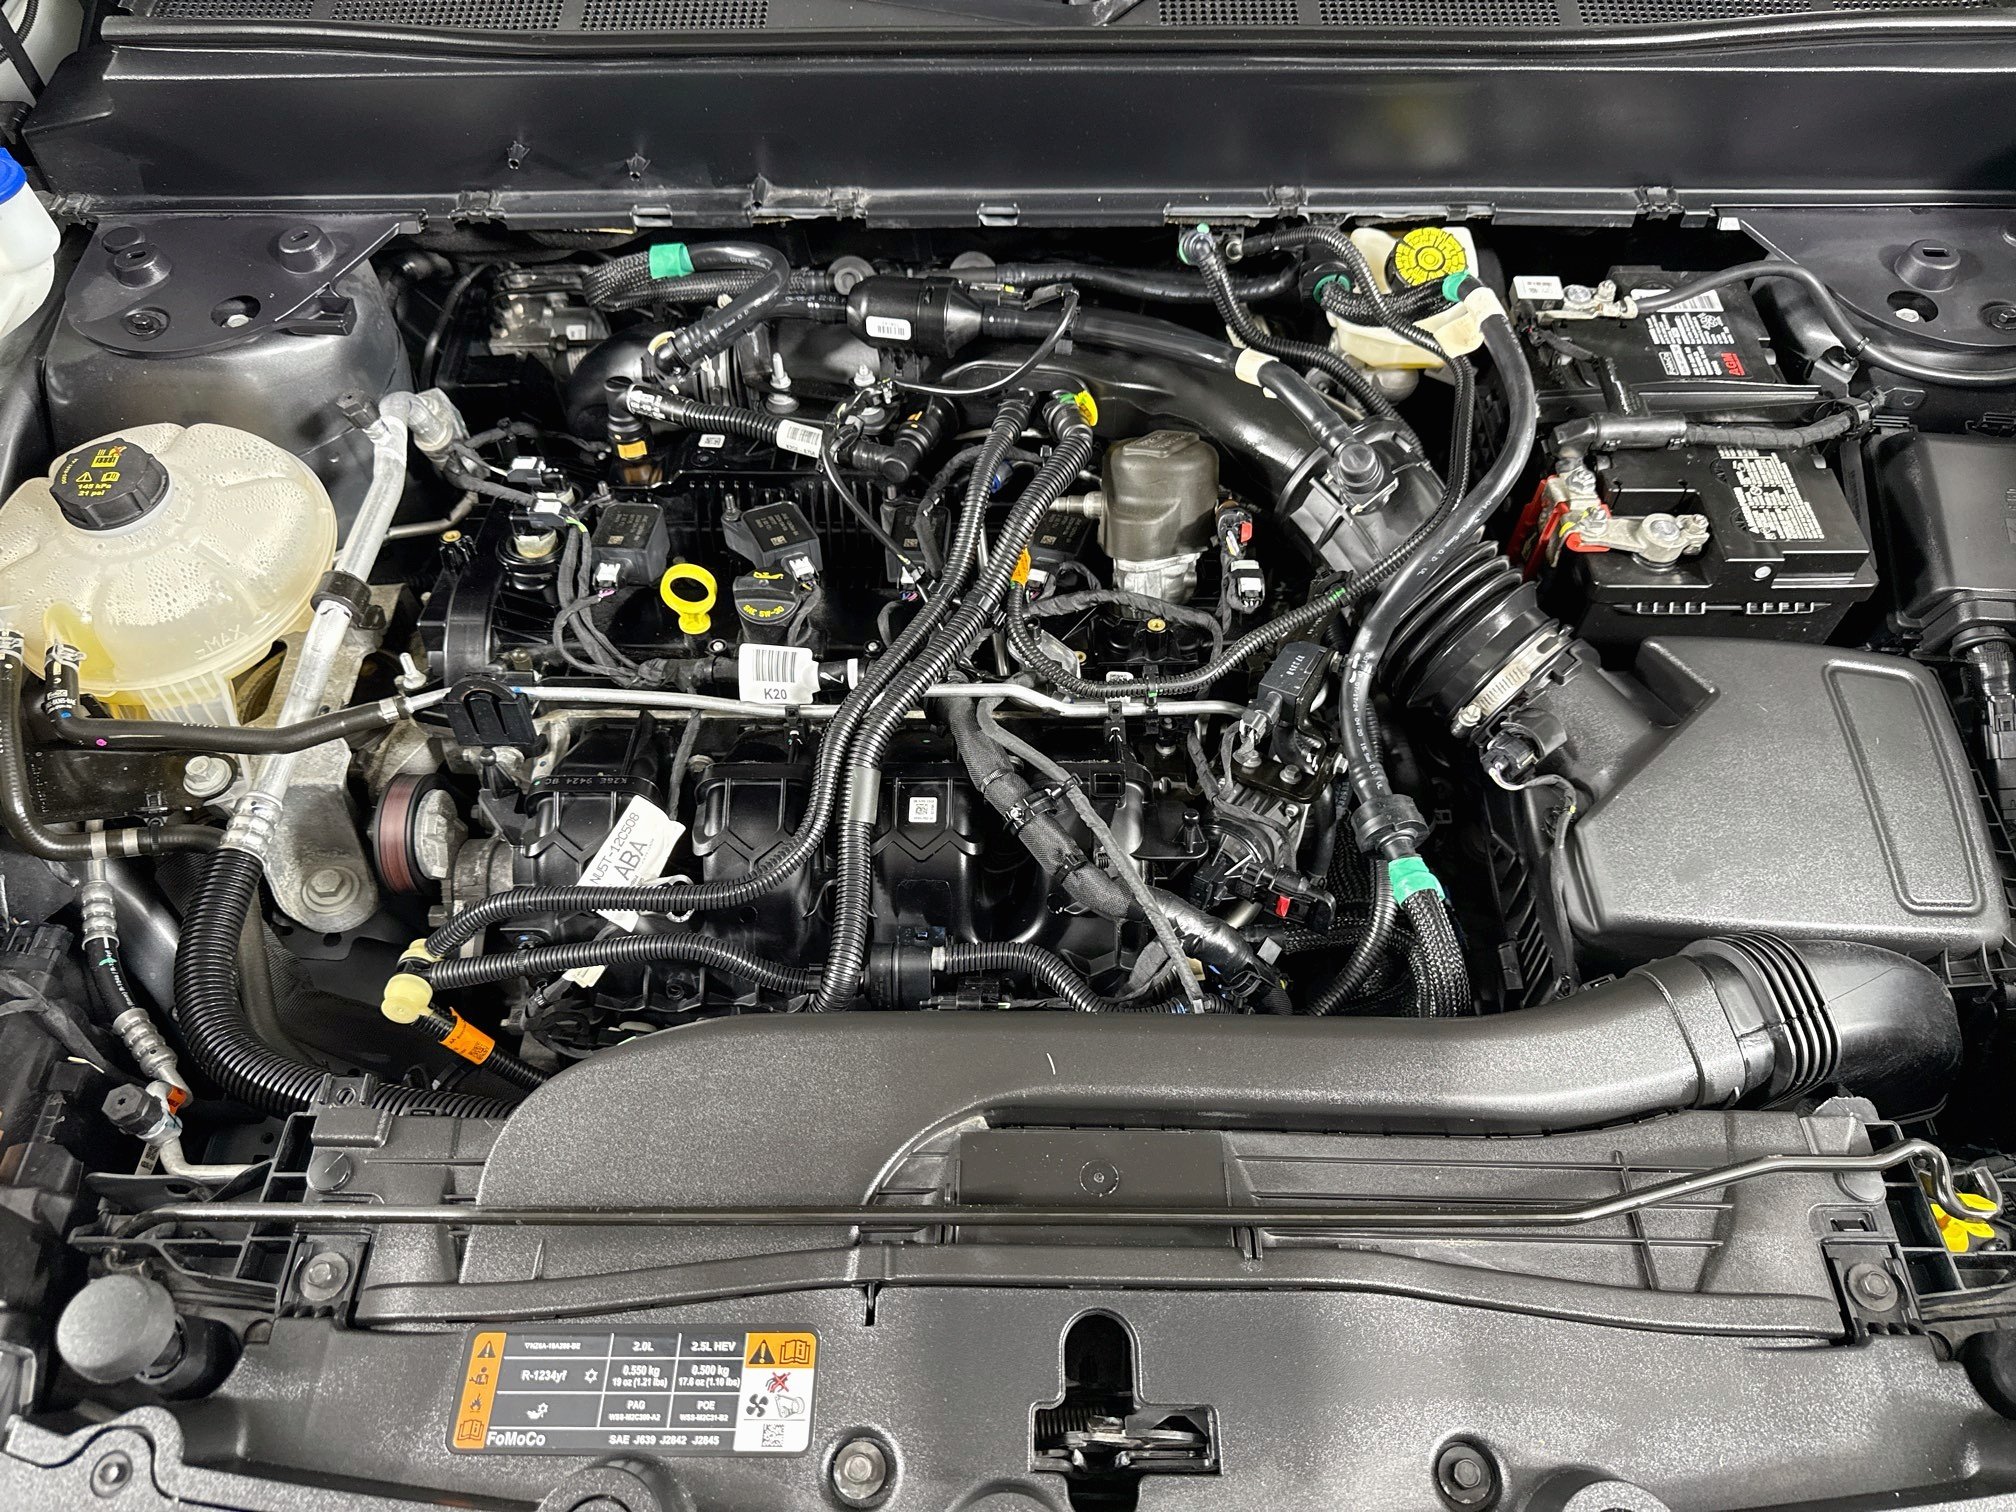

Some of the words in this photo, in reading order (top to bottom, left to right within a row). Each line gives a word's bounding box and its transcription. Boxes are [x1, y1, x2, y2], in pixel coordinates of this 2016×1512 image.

[1721, 352, 1741, 376] AGM
[742, 603, 758, 617] SAE
[758, 604, 785, 618] 5W-30
[203, 624, 249, 652] MAX
[763, 687, 788, 701] K20
[614, 839, 648, 880] ABA
[632, 1341, 654, 1352] 2.0L
[690, 1341, 713, 1352] 2.5L
[713, 1341, 737, 1352] HEV
[521, 1369, 568, 1384] R-1234yf
[622, 1364, 647, 1376] 0.550
[648, 1365, 661, 1378] kg
[690, 1364, 716, 1376] 0.500
[716, 1365, 730, 1378] kg
[612, 1377, 622, 1387] 19
[622, 1379, 633, 1387] oz
[633, 1377, 652, 1388] (1.21
[652, 1377, 668, 1388] lbs)
[678, 1377, 695, 1387] 17.6
[695, 1379, 705, 1387] oz
[725, 1377, 741, 1388] lbs)
[626, 1400, 646, 1410] PAG
[696, 1400, 716, 1410] POE
[486, 1431, 546, 1447] FoMoCo
[608, 1434, 630, 1445] SAE
[632, 1434, 657, 1445] J639
[659, 1435, 687, 1445] J2842
[691, 1435, 720, 1446] J2845
